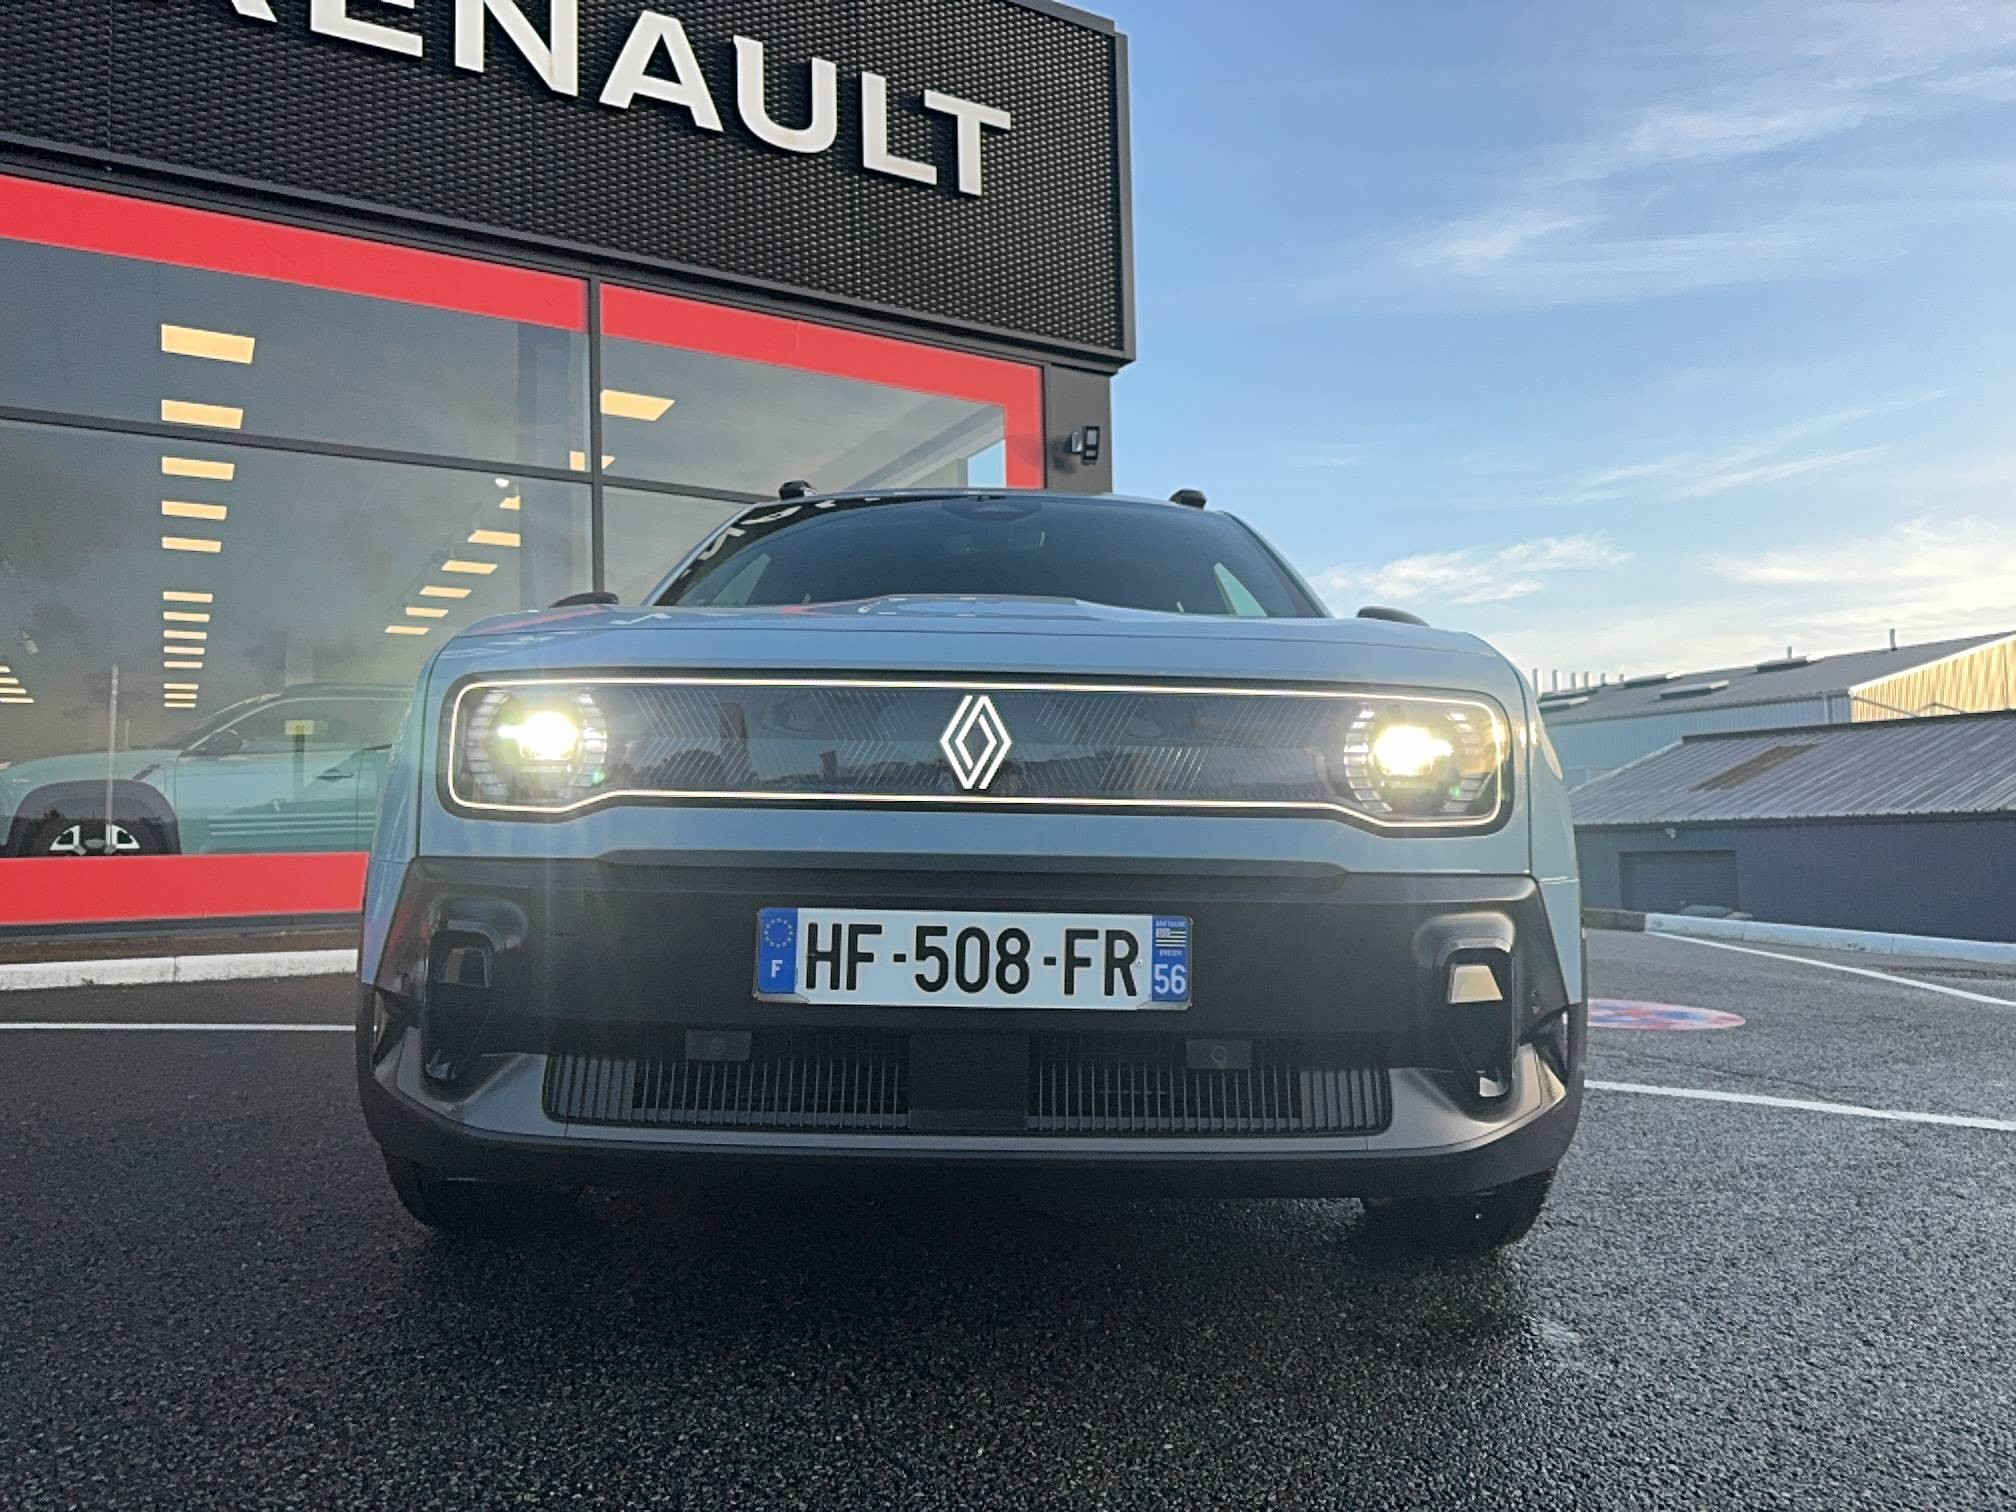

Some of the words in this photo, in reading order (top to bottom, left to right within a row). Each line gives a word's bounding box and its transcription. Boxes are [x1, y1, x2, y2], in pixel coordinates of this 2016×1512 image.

[230, 0, 1011, 196] NAULT
[771, 960, 783, 978] F
[805, 922, 1139, 996] HF-508-FR
[1154, 963, 1187, 994] 56
